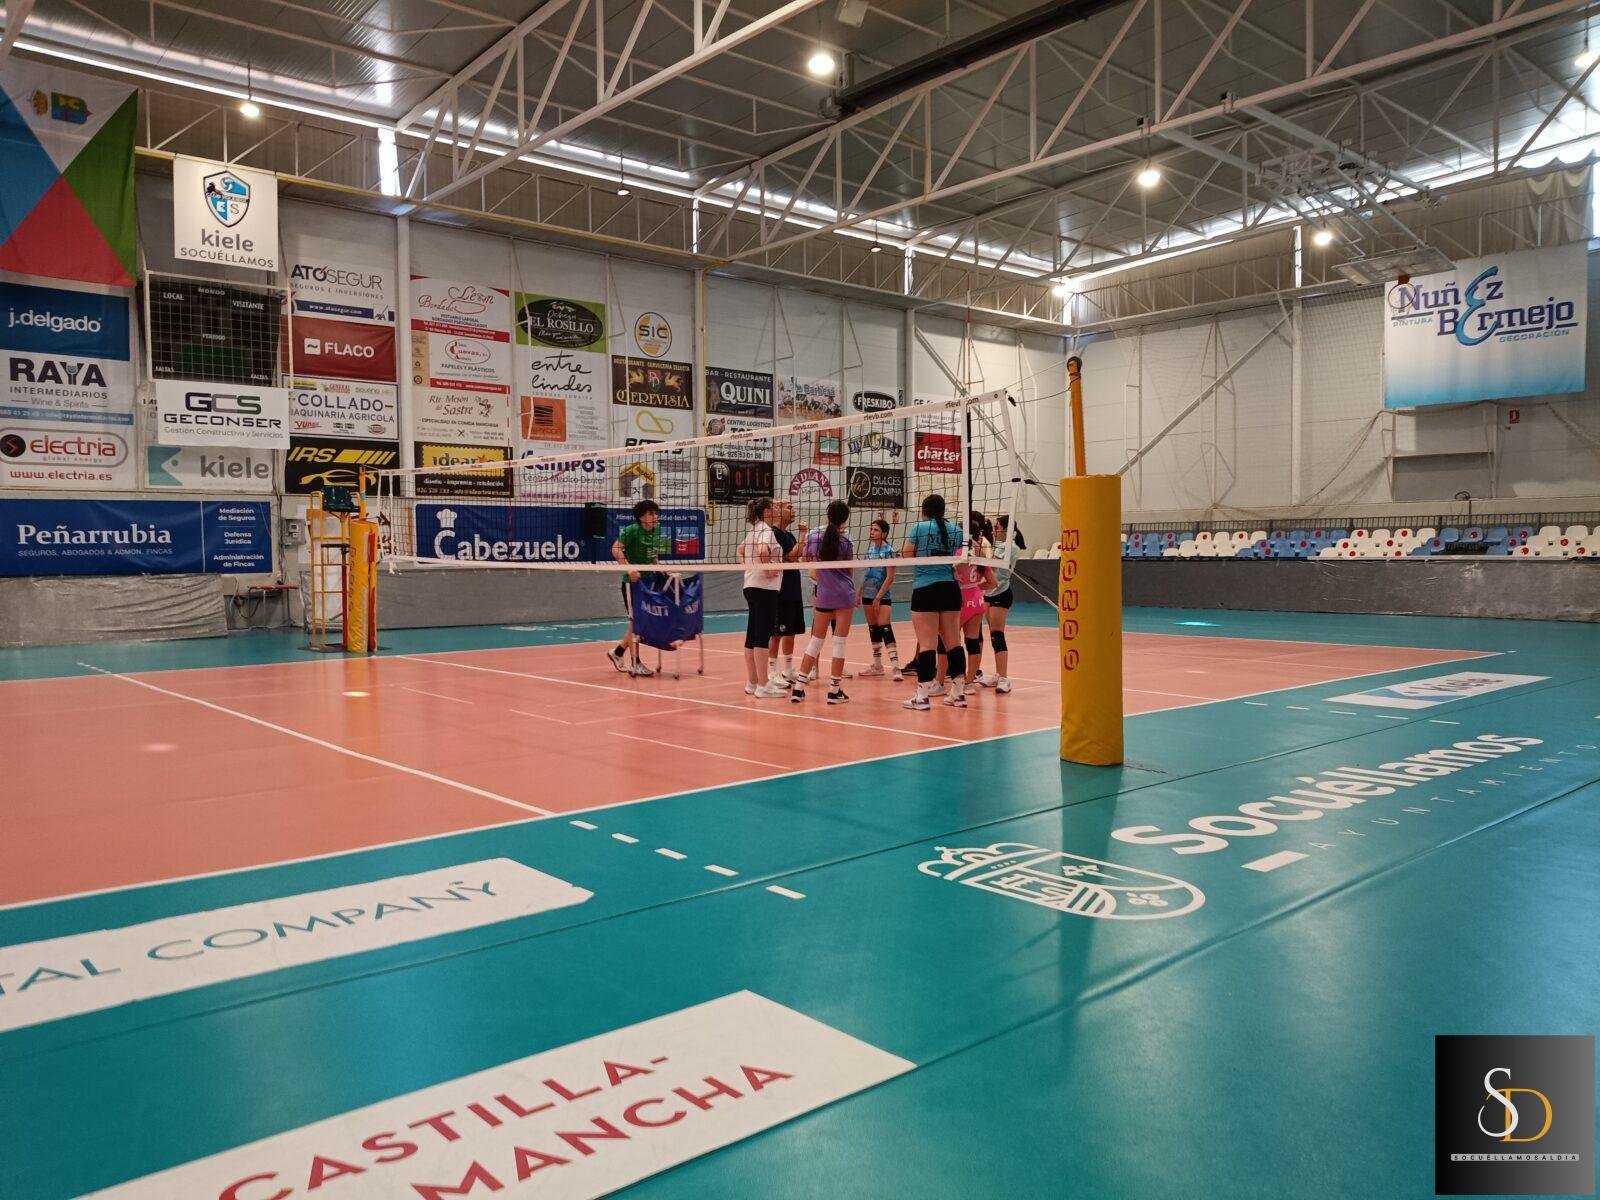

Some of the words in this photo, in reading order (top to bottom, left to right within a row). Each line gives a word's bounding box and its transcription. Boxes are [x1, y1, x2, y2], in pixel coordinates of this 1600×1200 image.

[201, 228, 254, 252] kiele
[180, 247, 274, 269] SOCUÉLLAMOS
[163, 292, 184, 301] LOCAL
[232, 300, 264, 310] VISITANTE
[8, 307, 101, 333] j.delgado
[547, 318, 594, 333] ROSILLO
[1393, 317, 1433, 327] PINTURA
[639, 325, 668, 339] SIC
[324, 342, 375, 358] FLACO
[531, 350, 592, 374] entre
[9, 357, 108, 388] RAYA
[724, 371, 772, 382] RESTAURANTE
[532, 374, 592, 392] lindes
[9, 386, 108, 400] INTERMEDIARIOS
[720, 381, 770, 404] QUINI
[185, 391, 262, 415] GCS
[298, 393, 383, 412] COLLADO
[857, 397, 892, 409] FRESKIBO
[164, 413, 282, 429] GECONSER
[349, 412, 396, 423] AGRICOLA
[30, 434, 116, 456] electria
[917, 446, 960, 461] charter
[288, 447, 336, 463] IRS
[10, 470, 113, 481] www.electria.es
[200, 455, 269, 479] kiele
[17, 523, 173, 545] Peñarrubia
[434, 530, 580, 560] Cabezuelo
[1111, 733, 1544, 855] Socuéllamos
[1308, 744, 1598, 850] AYUNTAMIENTO
[411, 1064, 796, 1200] MANCHA
